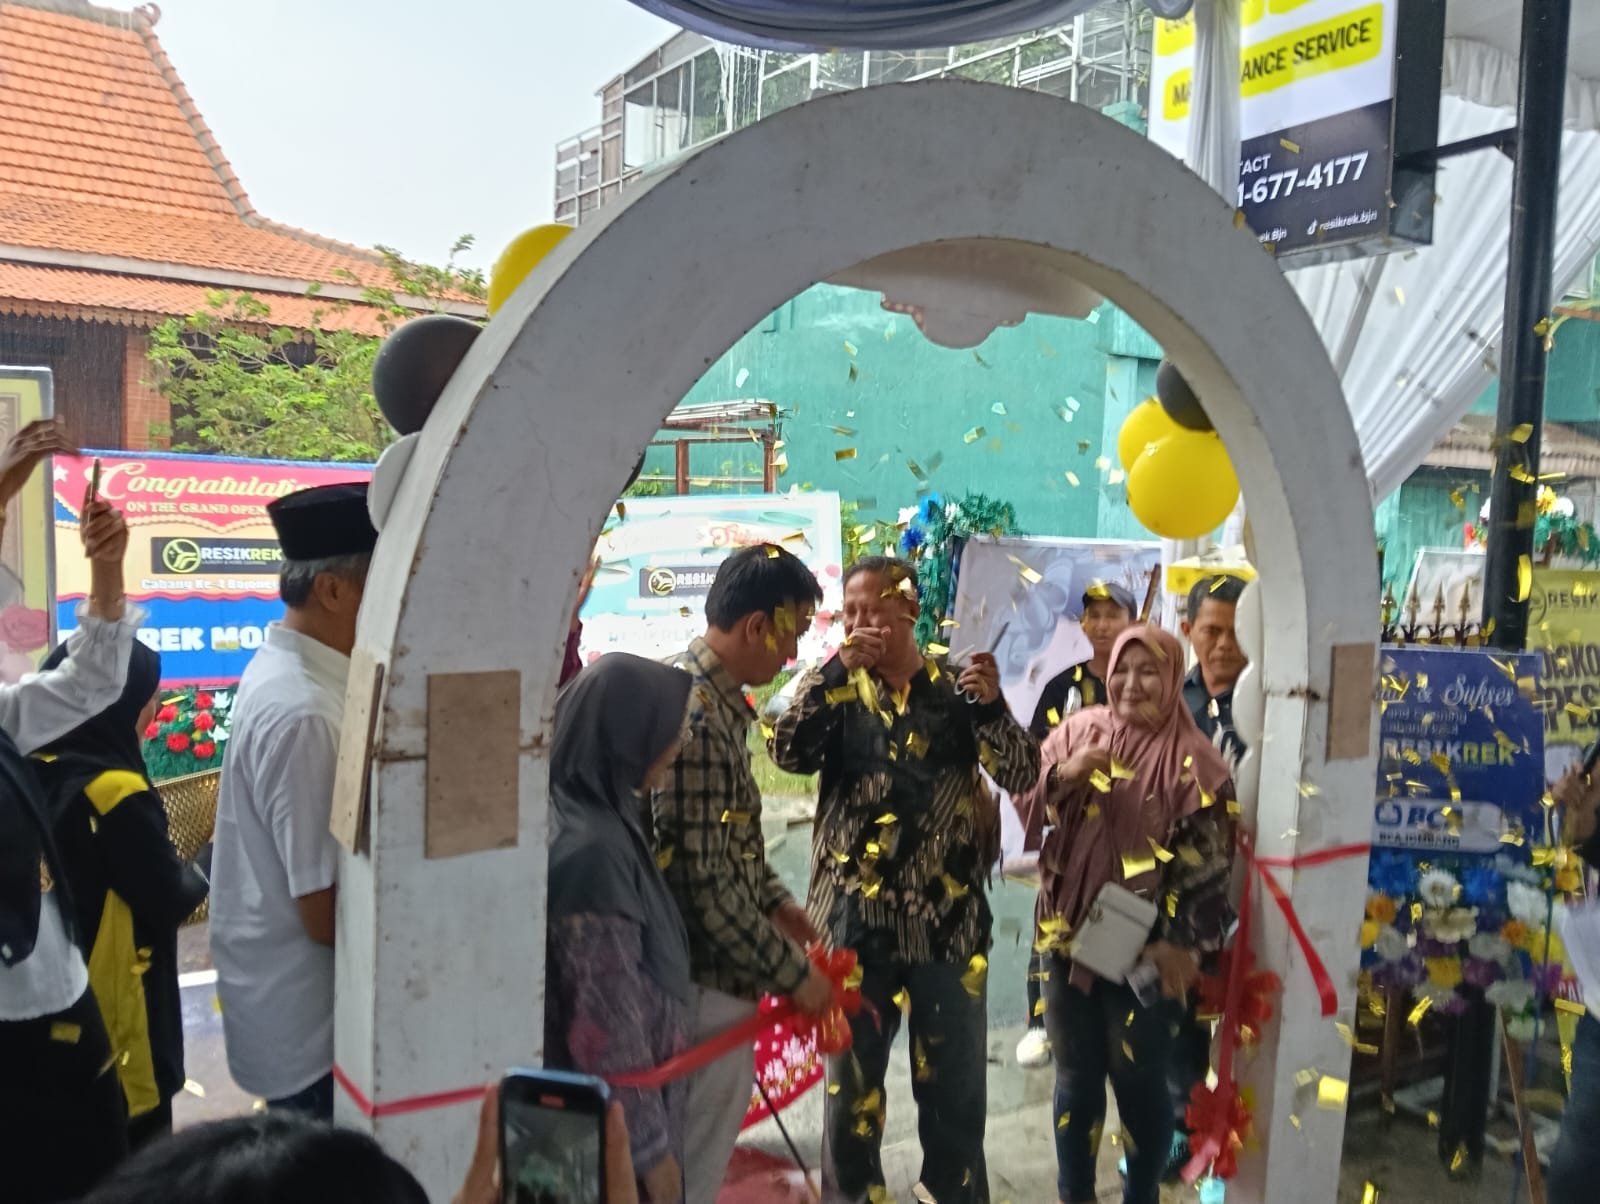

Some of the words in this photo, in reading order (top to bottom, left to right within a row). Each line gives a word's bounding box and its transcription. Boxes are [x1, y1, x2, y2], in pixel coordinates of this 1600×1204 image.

[1293, 18, 1372, 65] SERVICE
[126, 502, 147, 512] ON
[151, 502, 177, 514] THE
[180, 503, 229, 514] GRAND
[201, 547, 282, 561] RESIKREK
[1441, 673, 1515, 708] Sukses
